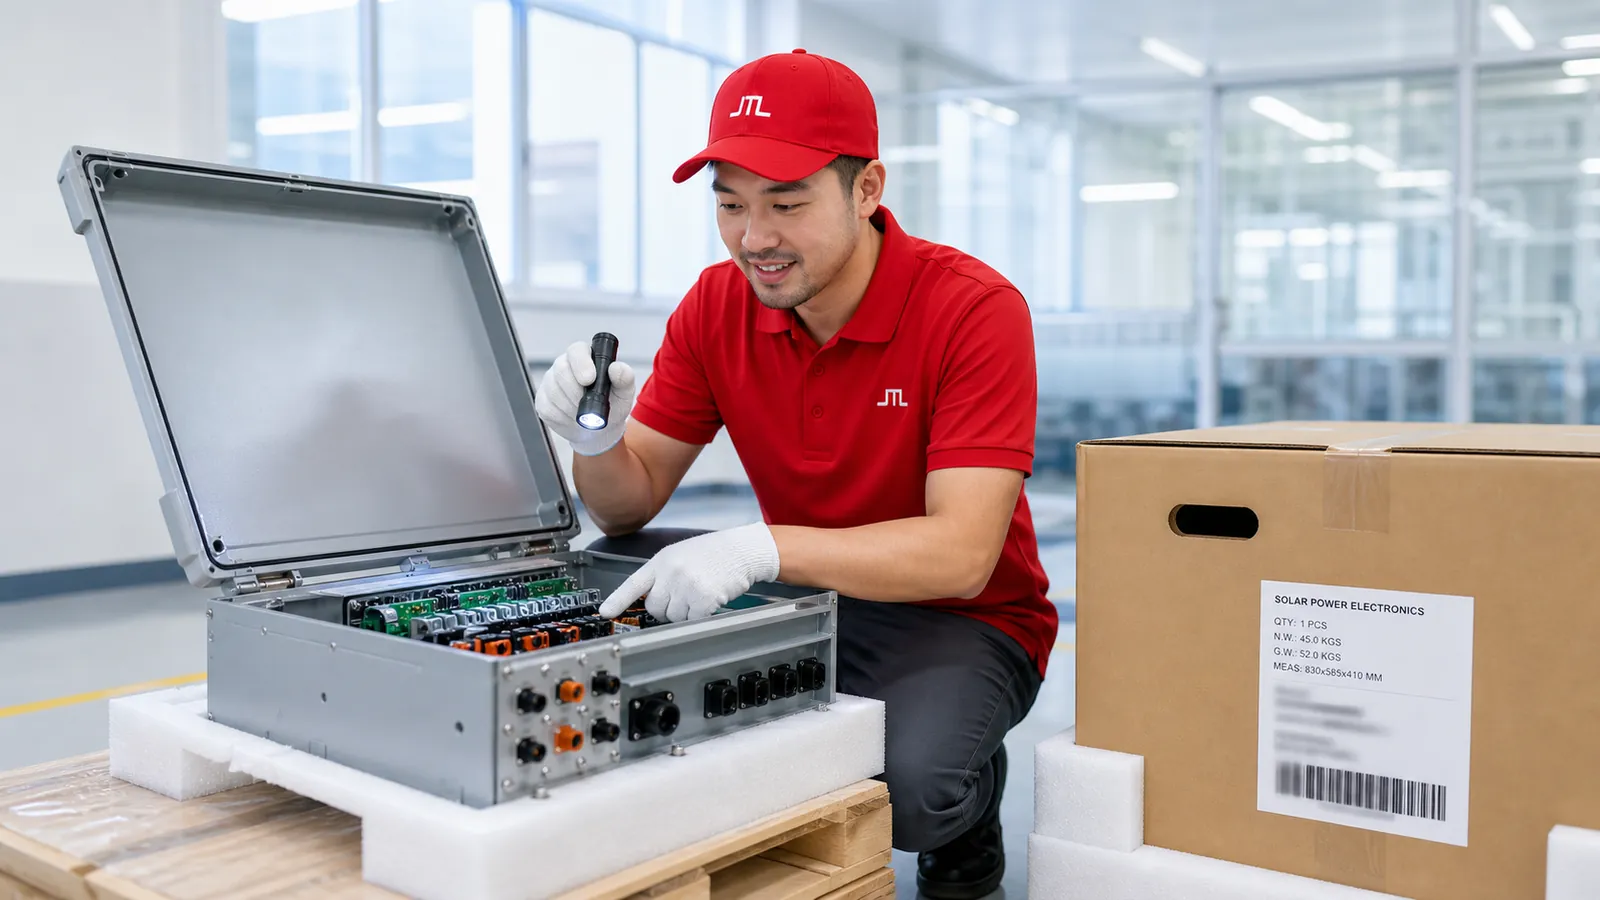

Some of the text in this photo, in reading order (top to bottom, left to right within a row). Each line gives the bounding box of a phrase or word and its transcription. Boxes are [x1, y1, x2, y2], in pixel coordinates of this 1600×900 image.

[1274, 595, 1425, 616] SOLAR POWER ELECTRONICS
[1274, 617, 1296, 628] QTY:
[1308, 620, 1328, 630] PCS
[1299, 635, 1319, 644] 45.0
[1321, 637, 1342, 647] KGS
[1299, 650, 1319, 660] 52.0
[1321, 652, 1342, 662] KGS
[1273, 662, 1303, 673] MEAS:
[1365, 673, 1383, 682] MM
